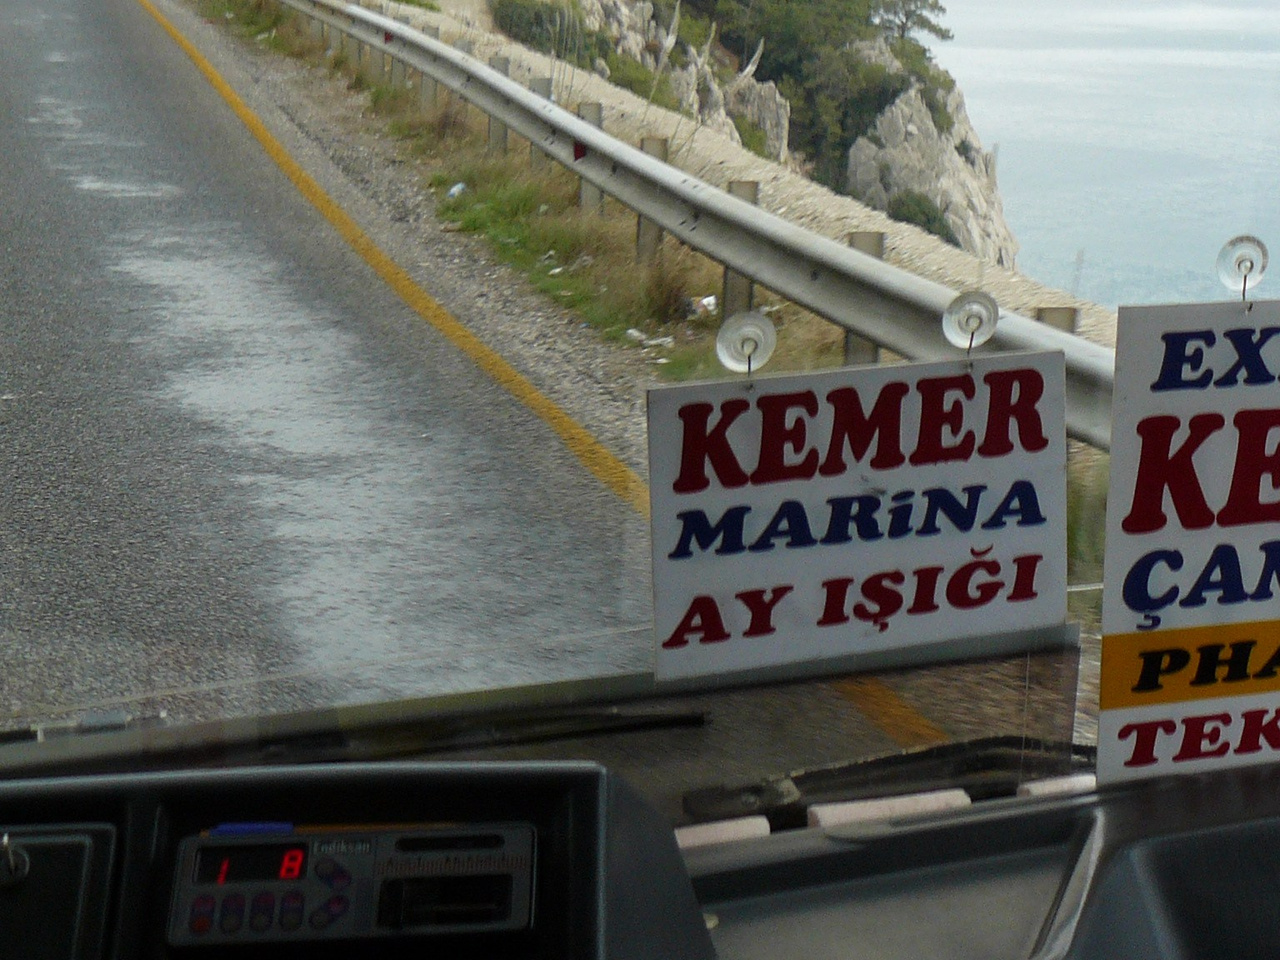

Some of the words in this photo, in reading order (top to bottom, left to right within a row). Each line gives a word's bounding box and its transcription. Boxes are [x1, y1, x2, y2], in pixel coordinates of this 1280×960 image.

[672, 368, 1049, 494] KEMER
[662, 585, 794, 649] AY
[816, 544, 1044, 632] IŞIĞI
[279, 849, 304, 880] 8
